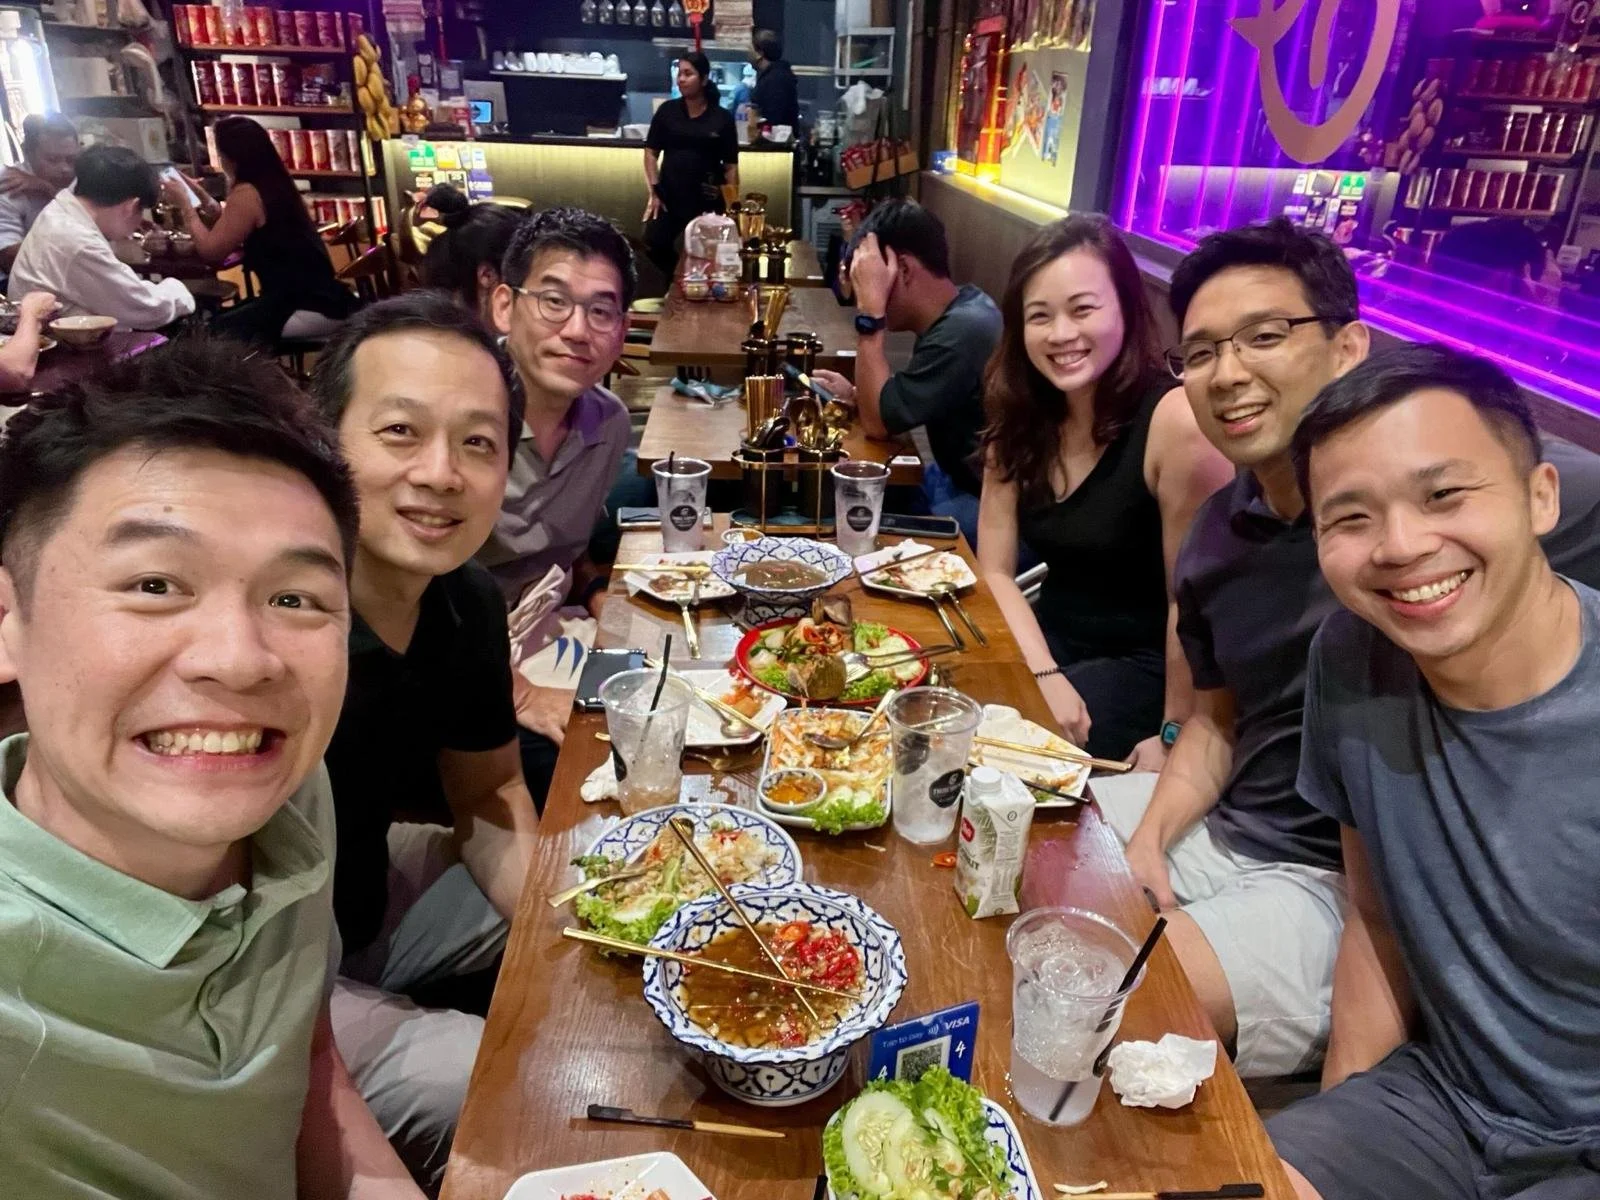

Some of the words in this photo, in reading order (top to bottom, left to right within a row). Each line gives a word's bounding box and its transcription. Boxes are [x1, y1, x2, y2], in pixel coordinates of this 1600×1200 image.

[944, 1015, 970, 1030] VISA
[898, 1035, 908, 1044] to
[909, 1032, 924, 1041] pay
[954, 1040, 966, 1058] 4
